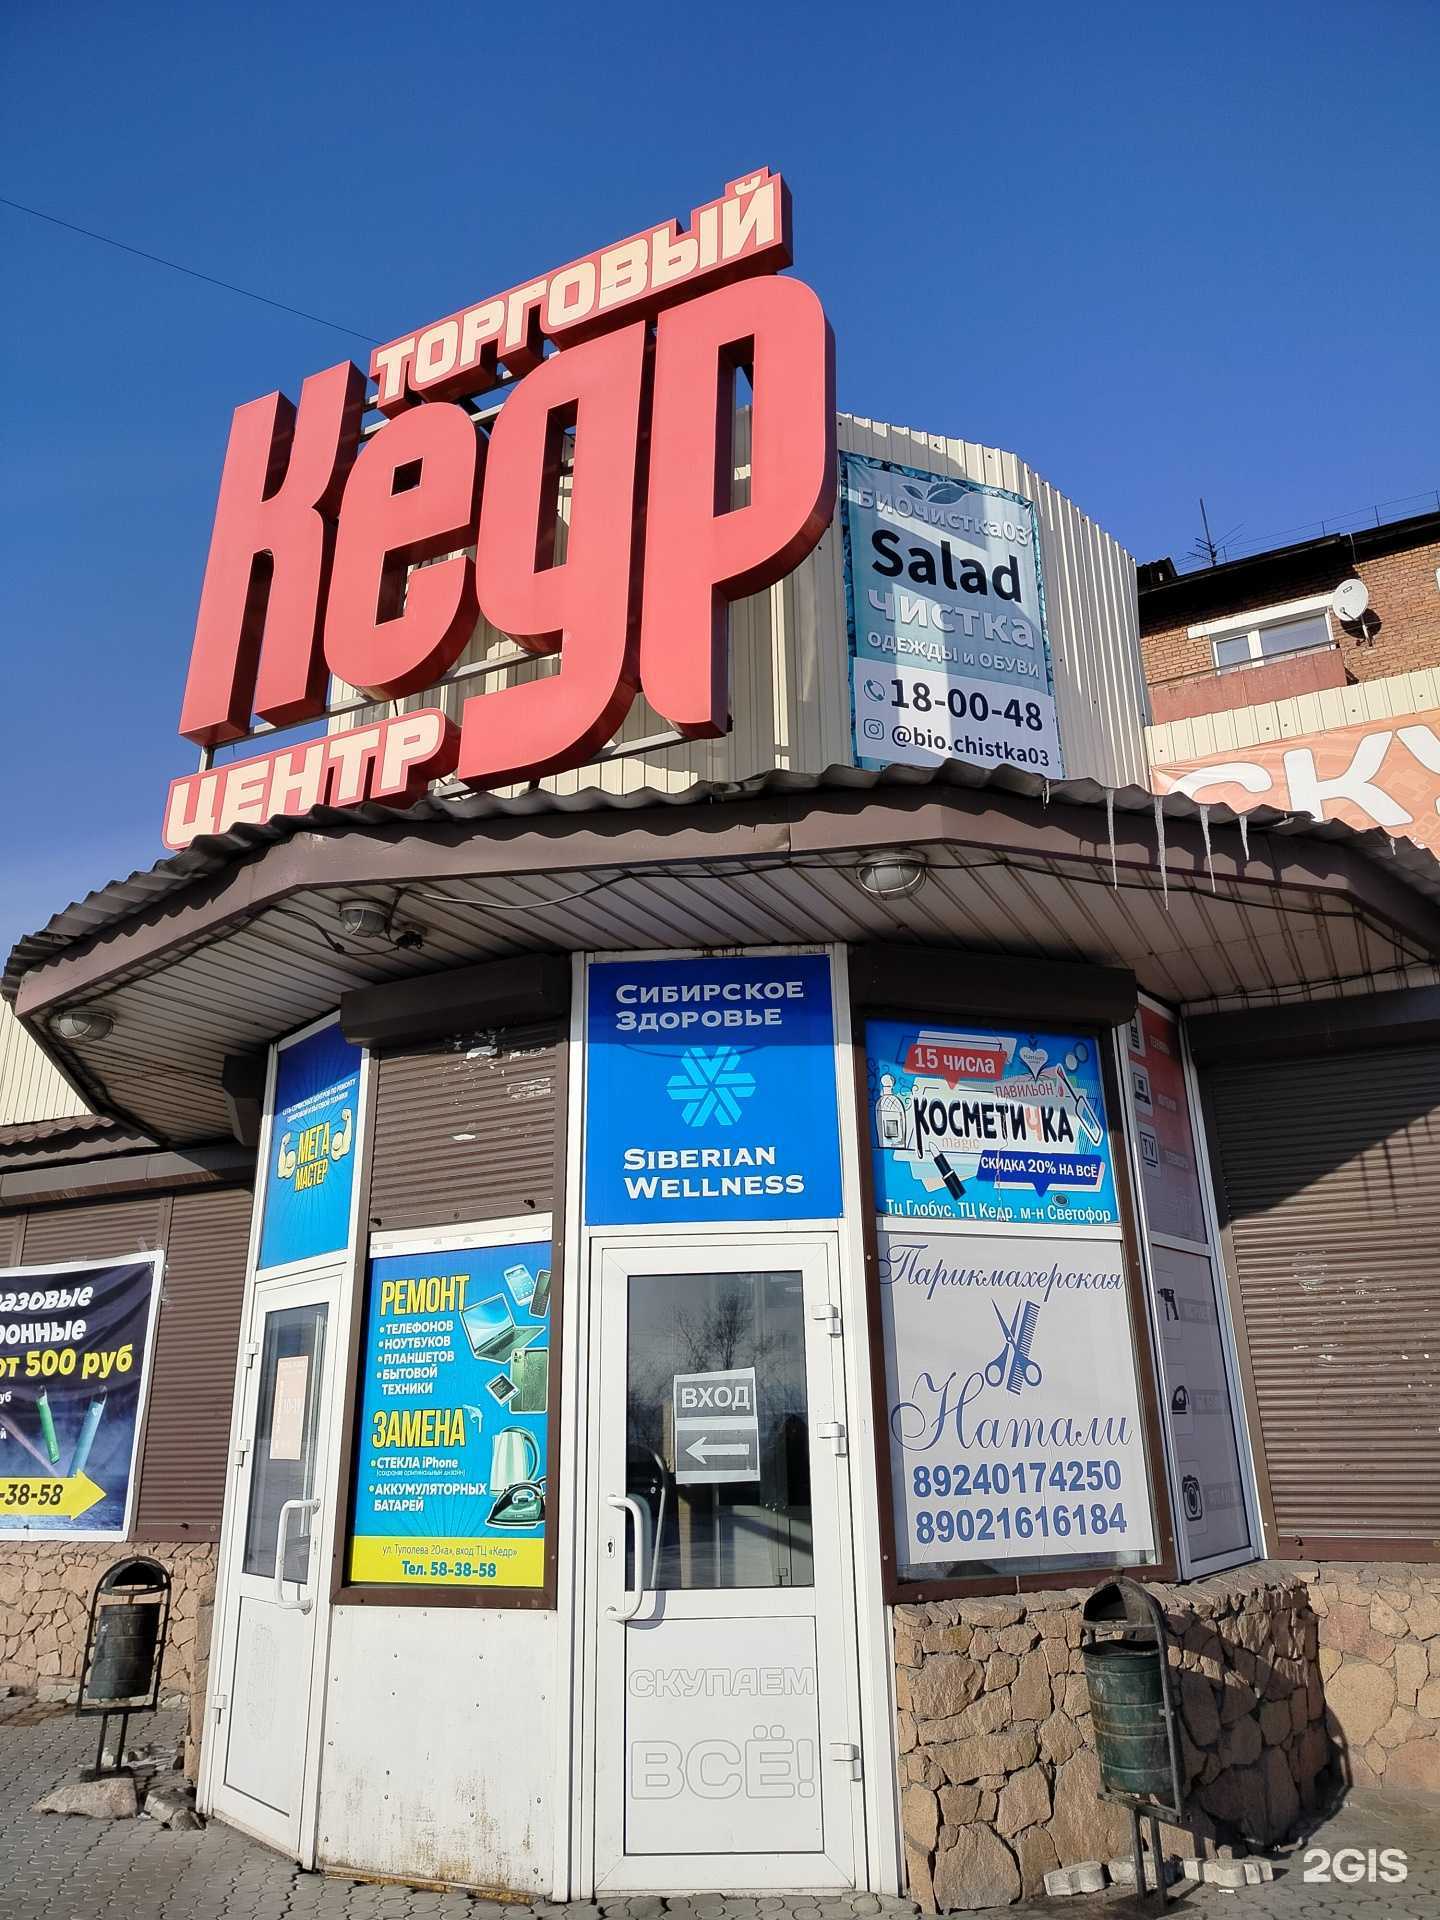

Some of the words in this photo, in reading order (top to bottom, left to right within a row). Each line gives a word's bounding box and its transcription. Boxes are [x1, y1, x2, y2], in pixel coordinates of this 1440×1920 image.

[375, 173, 776, 402] ТОРГОВЫЙ
[871, 528, 1022, 604] Salad
[867, 631, 958, 664] ОДЕЖДЫ
[979, 652, 1040, 679] ОБУВИ
[890, 678, 1043, 732] 18-00-48
[891, 725, 1050, 767] @bio.chistka03
[165, 714, 442, 846] ЦЕНТР
[914, 1046, 939, 1069] 15
[943, 1055, 996, 1074] числа
[994, 1082, 1054, 1099] ПАВИЛЬОН
[297, 1120, 331, 1166] МЕГА
[912, 1096, 1075, 1159] КОСМЕТИЧКА
[294, 1157, 329, 1192] МАСТЕР
[980, 1156, 1026, 1174] СКИДКА
[1027, 1158, 1057, 1175] 20%
[1059, 1163, 1075, 1177] НА
[1076, 1163, 1098, 1179] ВСЁ
[958, 1201, 977, 1220] ТЦ
[1020, 1206, 1045, 1220] м-н
[1046, 1204, 1111, 1224] Светофор
[878, 1243, 1124, 1302] Парикмахерская
[0, 1286, 94, 1313] азовые
[380, 1274, 471, 1317] РЕМОНТ
[384, 1335, 451, 1350] НОУТБУКОВ
[386, 1320, 454, 1335] ТЕЛЕФОНОВ
[25, 1348, 77, 1377] 500
[82, 1343, 133, 1380] руб
[382, 1363, 438, 1380] БЫТОВОЙ
[383, 1350, 455, 1365] ПЛАНШЕТОВ
[381, 1382, 433, 1396] ТЕХНИКИ
[681, 1385, 751, 1412] ВХОД
[371, 1408, 467, 1449] ЗАМЕНА
[890, 1371, 1134, 1452] Натали
[376, 1456, 420, 1469] СТЕКЛА
[422, 1456, 459, 1469] iPhone
[912, 1459, 1122, 1498] 89240174250
[374, 1482, 488, 1496] АККУМУЛЯТОРНЫХ
[374, 1496, 424, 1512] БАТАРЕЙ
[915, 1502, 1128, 1545] 89021616184
[402, 1560, 428, 1576] Тел.
[430, 1561, 497, 1578] 58-38-58
[629, 1666, 815, 1698] СКУПАЕМ
[630, 1724, 816, 1800] ВСЁ!
